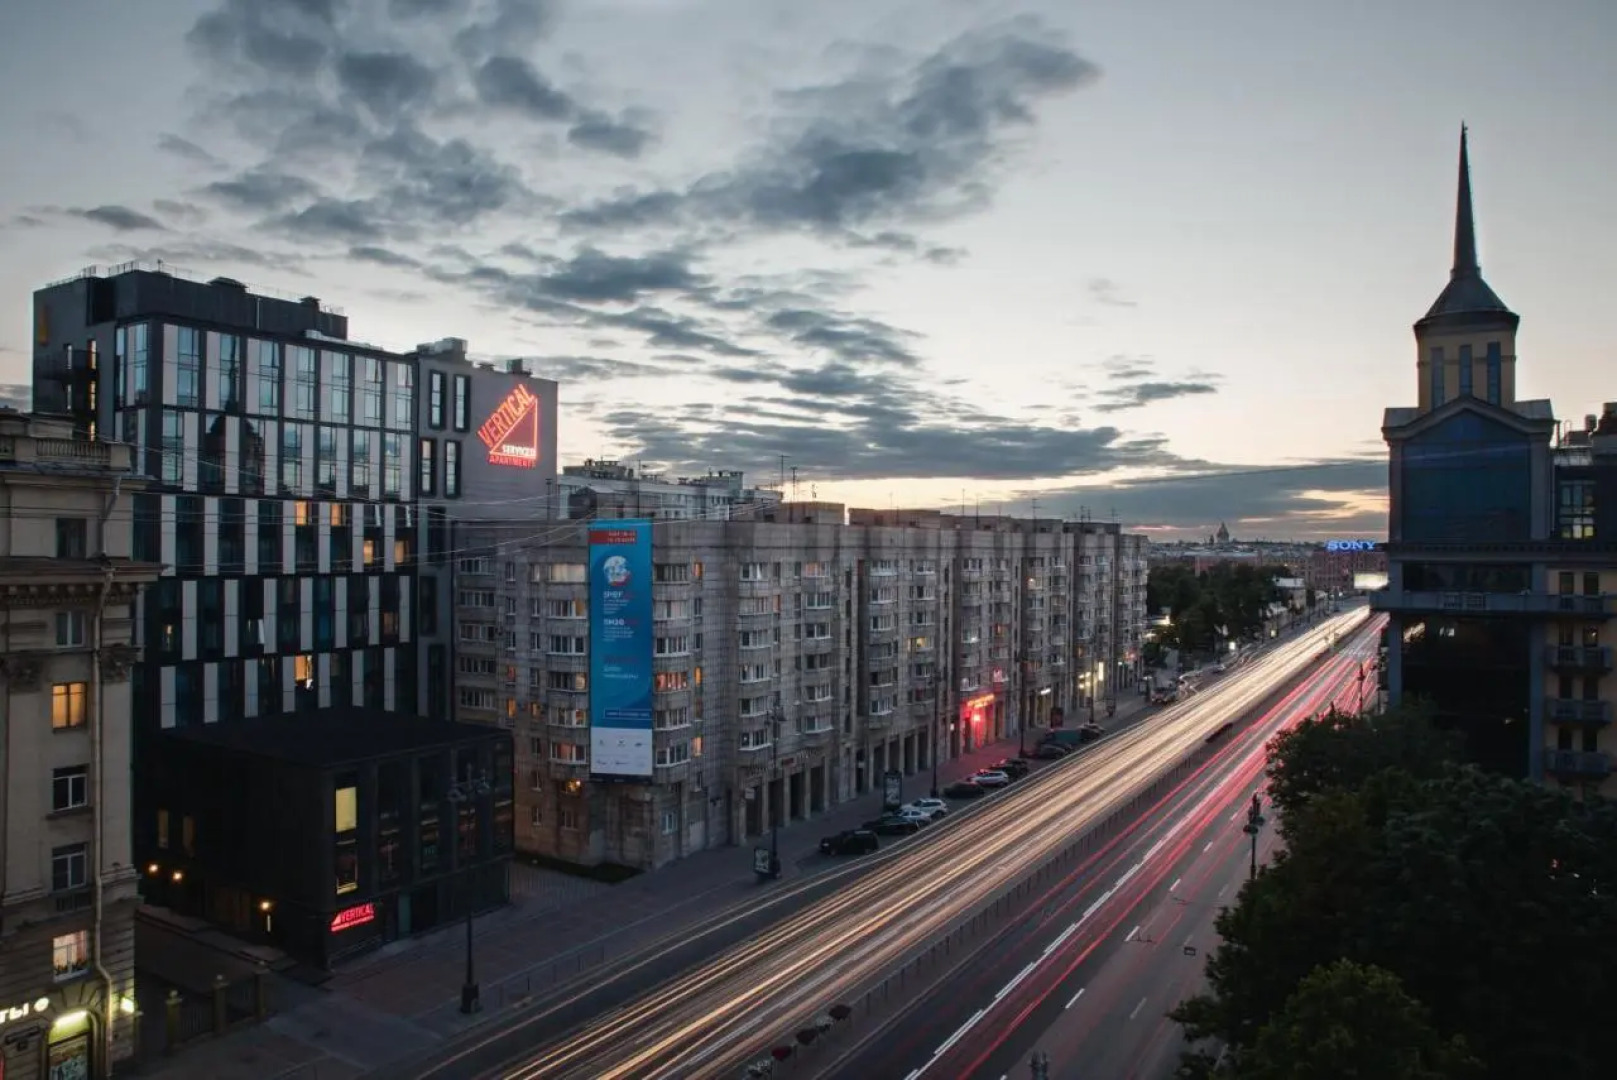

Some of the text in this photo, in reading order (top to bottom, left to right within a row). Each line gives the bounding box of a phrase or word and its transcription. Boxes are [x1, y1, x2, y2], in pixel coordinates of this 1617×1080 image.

[477, 384, 535, 448] VERTICAL
[1327, 540, 1376, 551] SONY
[341, 903, 375, 922] VERTICAL
